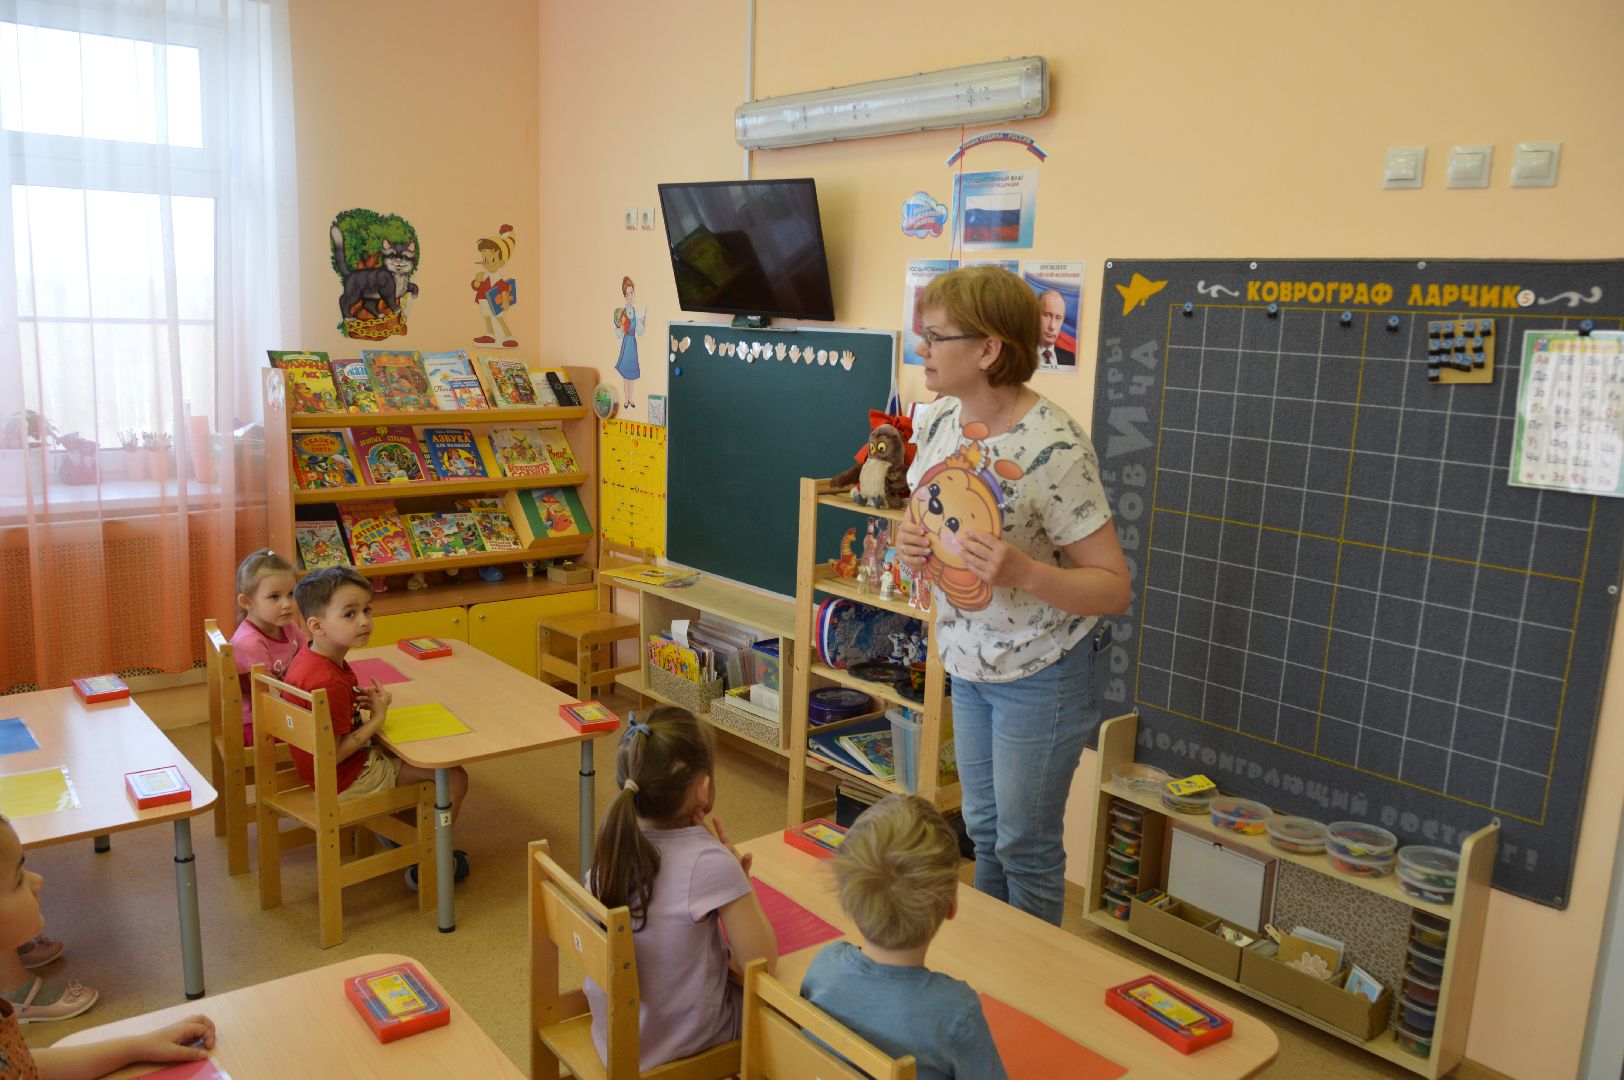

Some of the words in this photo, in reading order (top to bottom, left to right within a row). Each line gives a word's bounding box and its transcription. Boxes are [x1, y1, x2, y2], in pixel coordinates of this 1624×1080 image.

[1247, 280, 1394, 306] КОВРОГРАФ
[1407, 283, 1521, 309] ЛАРЧИК
[432, 434, 471, 443] АЗБУКА
[1139, 726, 1369, 817] ДОЛГОИГРАЮЩИЙ
[1380, 804, 1539, 872] ВОСТОГ!
[443, 815, 449, 823] 2
